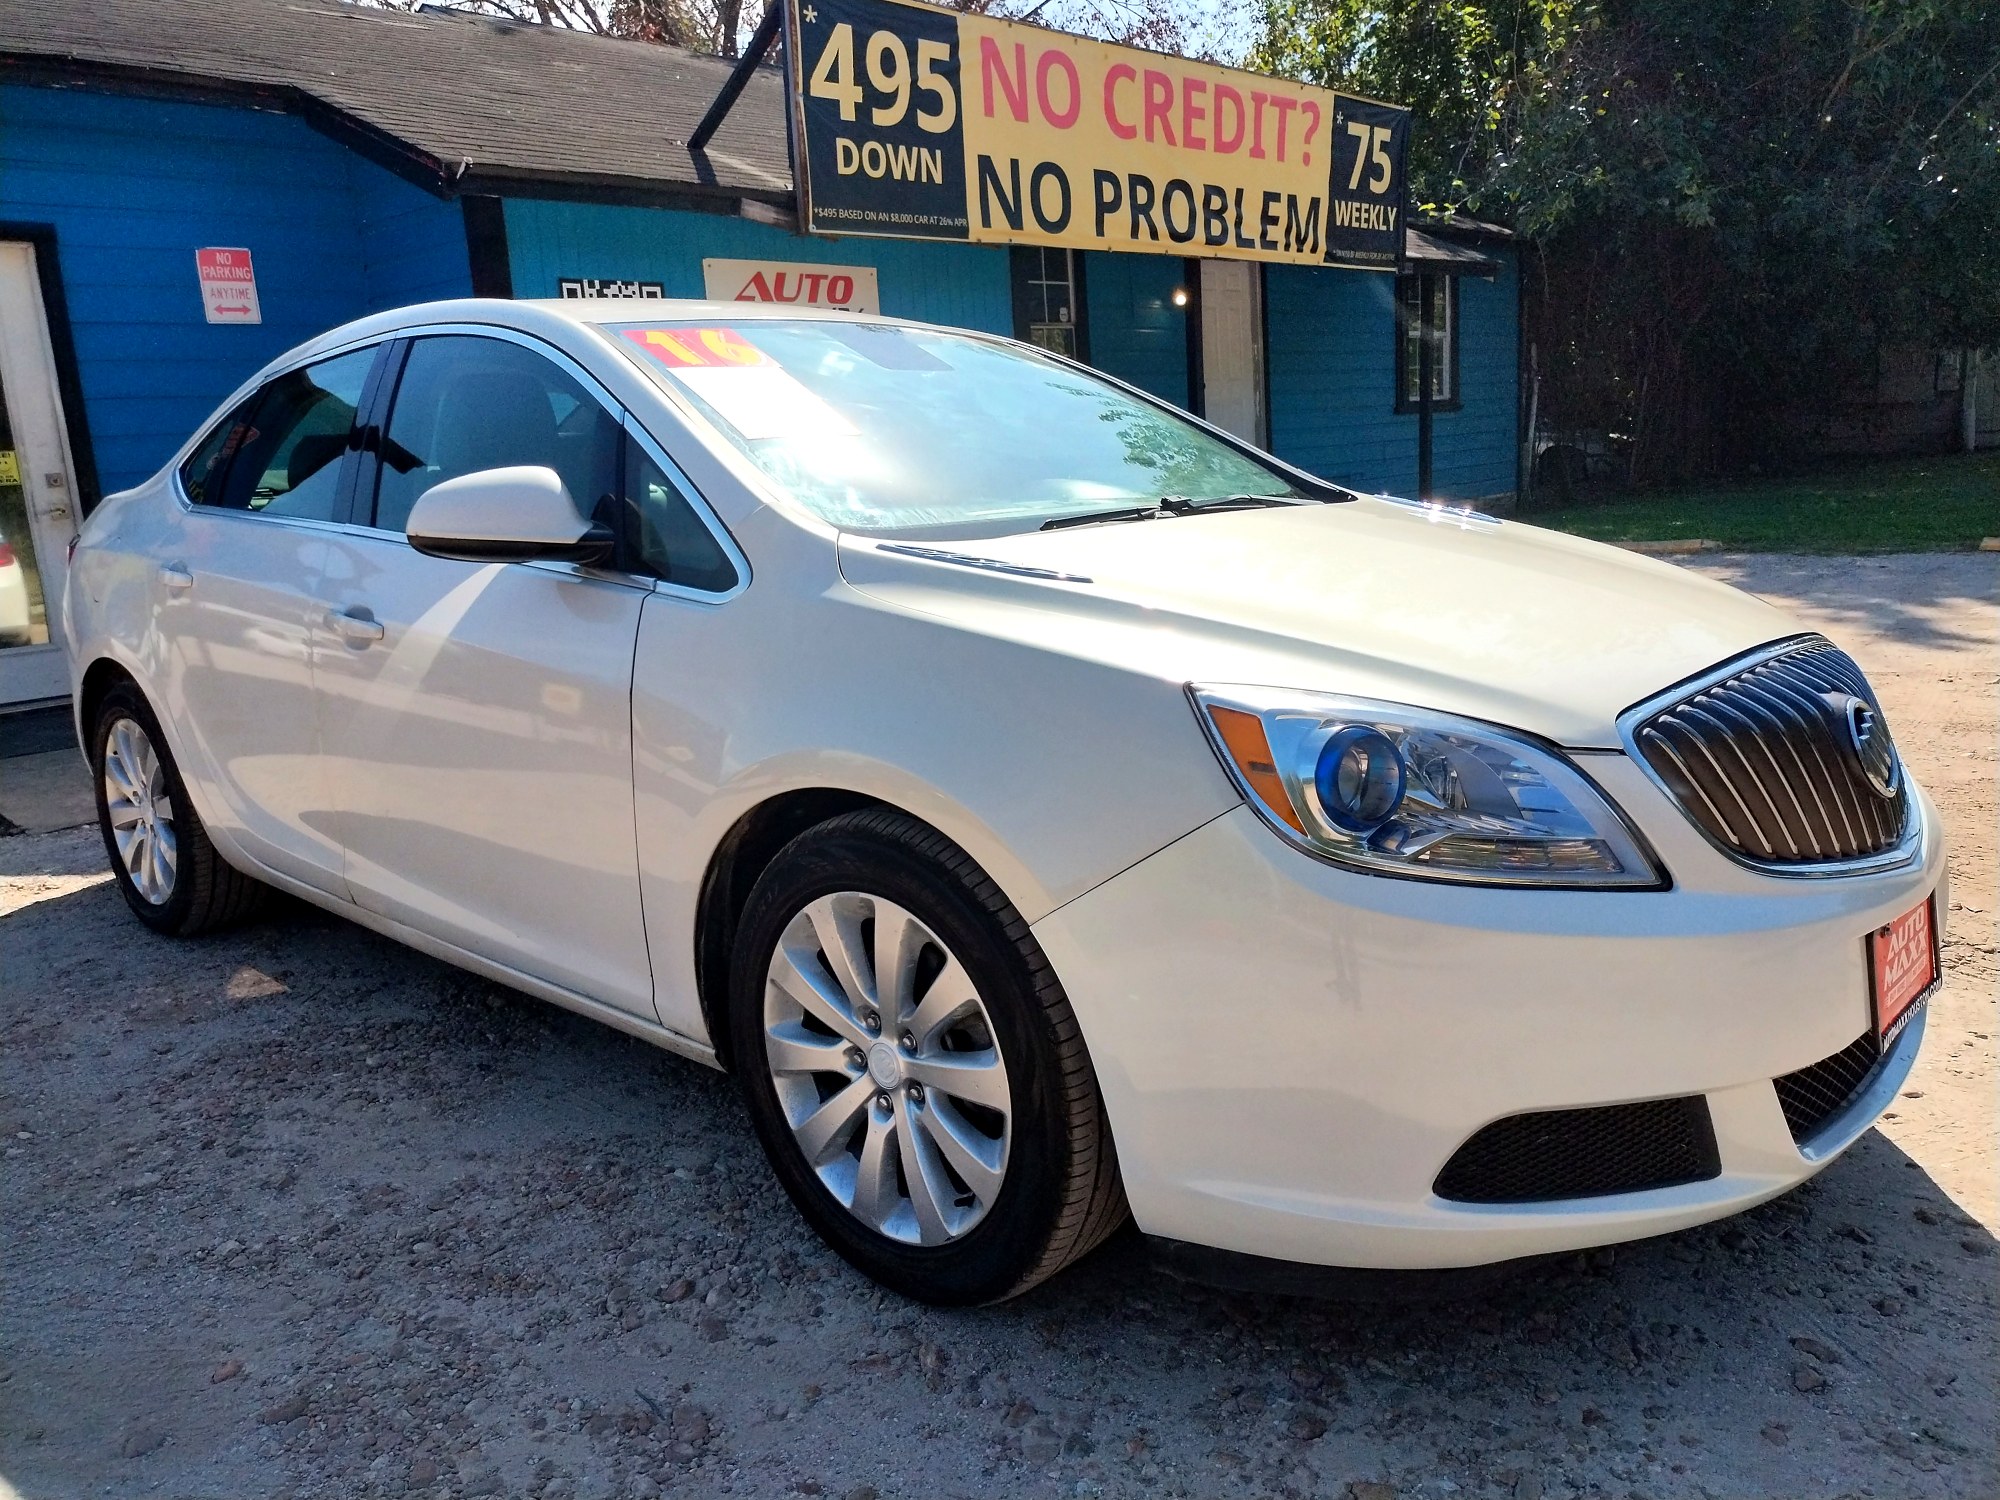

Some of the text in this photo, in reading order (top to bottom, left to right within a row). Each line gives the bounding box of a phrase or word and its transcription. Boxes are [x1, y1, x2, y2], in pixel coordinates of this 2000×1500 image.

[980, 36, 1321, 167] NO CREDIT?
[836, 138, 943, 185] DOWN
[838, 209, 863, 220] BASED
[865, 211, 877, 221] ON
[878, 213, 889, 222] AN
[890, 213, 914, 224] $8,000
[914, 215, 928, 225] CAR
[929, 216, 938, 225] AT
[939, 216, 954, 226] 26%
[954, 218, 968, 227] APR
[977, 154, 1322, 254] NO PROBLEM
[1334, 199, 1398, 231] WEEKLY
[202, 265, 251, 280] PARKING
[216, 252, 232, 265] NO
[210, 287, 251, 300] ANYTIME
[734, 271, 854, 305] AUTO
[645, 328, 767, 366] 16
[1887, 905, 1925, 963] AUTO
[1883, 925, 1928, 992] MAXX
